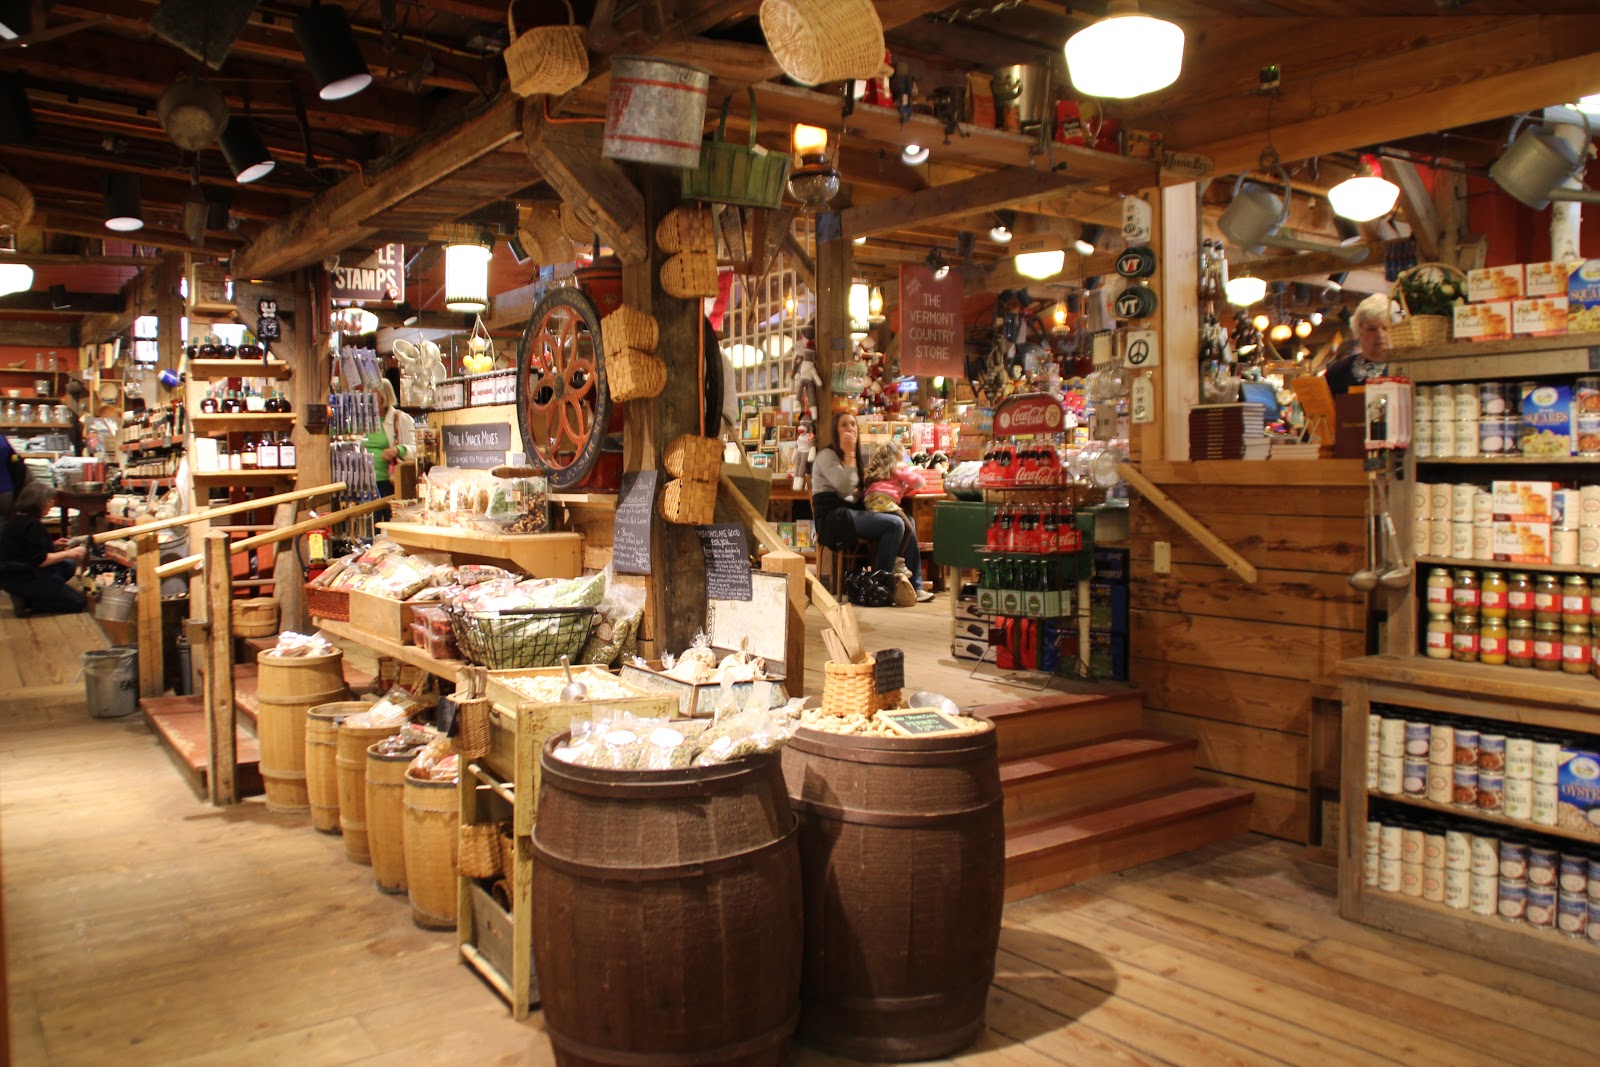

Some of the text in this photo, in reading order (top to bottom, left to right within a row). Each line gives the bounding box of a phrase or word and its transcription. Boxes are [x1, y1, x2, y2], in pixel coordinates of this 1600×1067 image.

[1019, 241, 1044, 250] CHEESE
[334, 267, 398, 292] STAMPS
[923, 293, 942, 308] THE
[1119, 299, 1138, 315] VT
[909, 310, 956, 327] VERMONT
[909, 327, 956, 344] COUNTRY
[916, 346, 950, 360] STORE
[1011, 406, 1045, 426] Coca-Cola
[1525, 411, 1569, 426] SQUARES
[1015, 466, 1057, 485] Coca-Cola
[727, 528, 741, 537] GOOD
[1562, 783, 1600, 801] OYSTE
